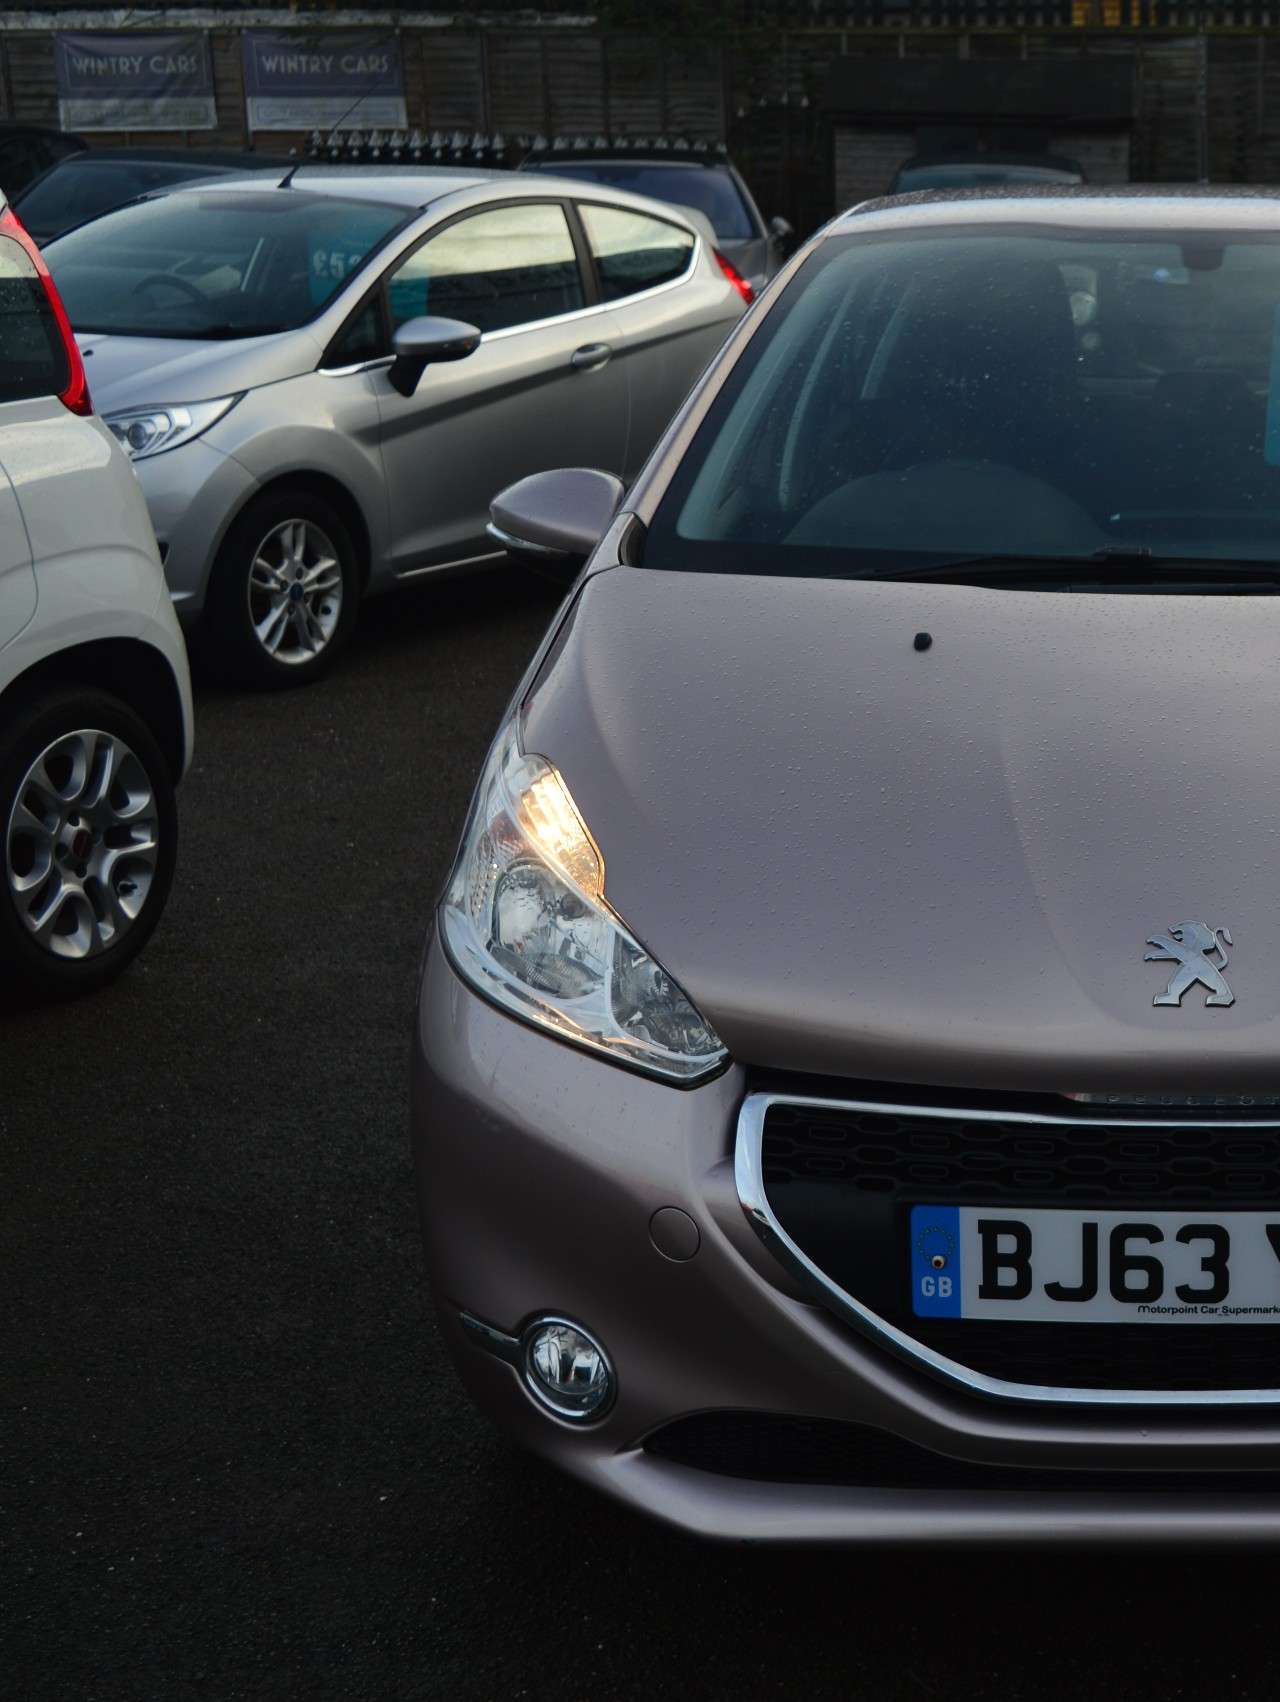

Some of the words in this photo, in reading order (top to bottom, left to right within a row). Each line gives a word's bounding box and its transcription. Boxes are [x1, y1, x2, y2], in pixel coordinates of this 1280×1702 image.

[72, 55, 144, 75] WINTRY
[149, 54, 199, 74] CARS
[261, 55, 334, 74] WINTRY
[339, 55, 389, 74] CARS
[977, 1218, 1231, 1304] BJ63
[920, 1276, 953, 1298] GB
[1137, 1305, 1198, 1315] Motorpoint
[1200, 1305, 1218, 1314] Car
